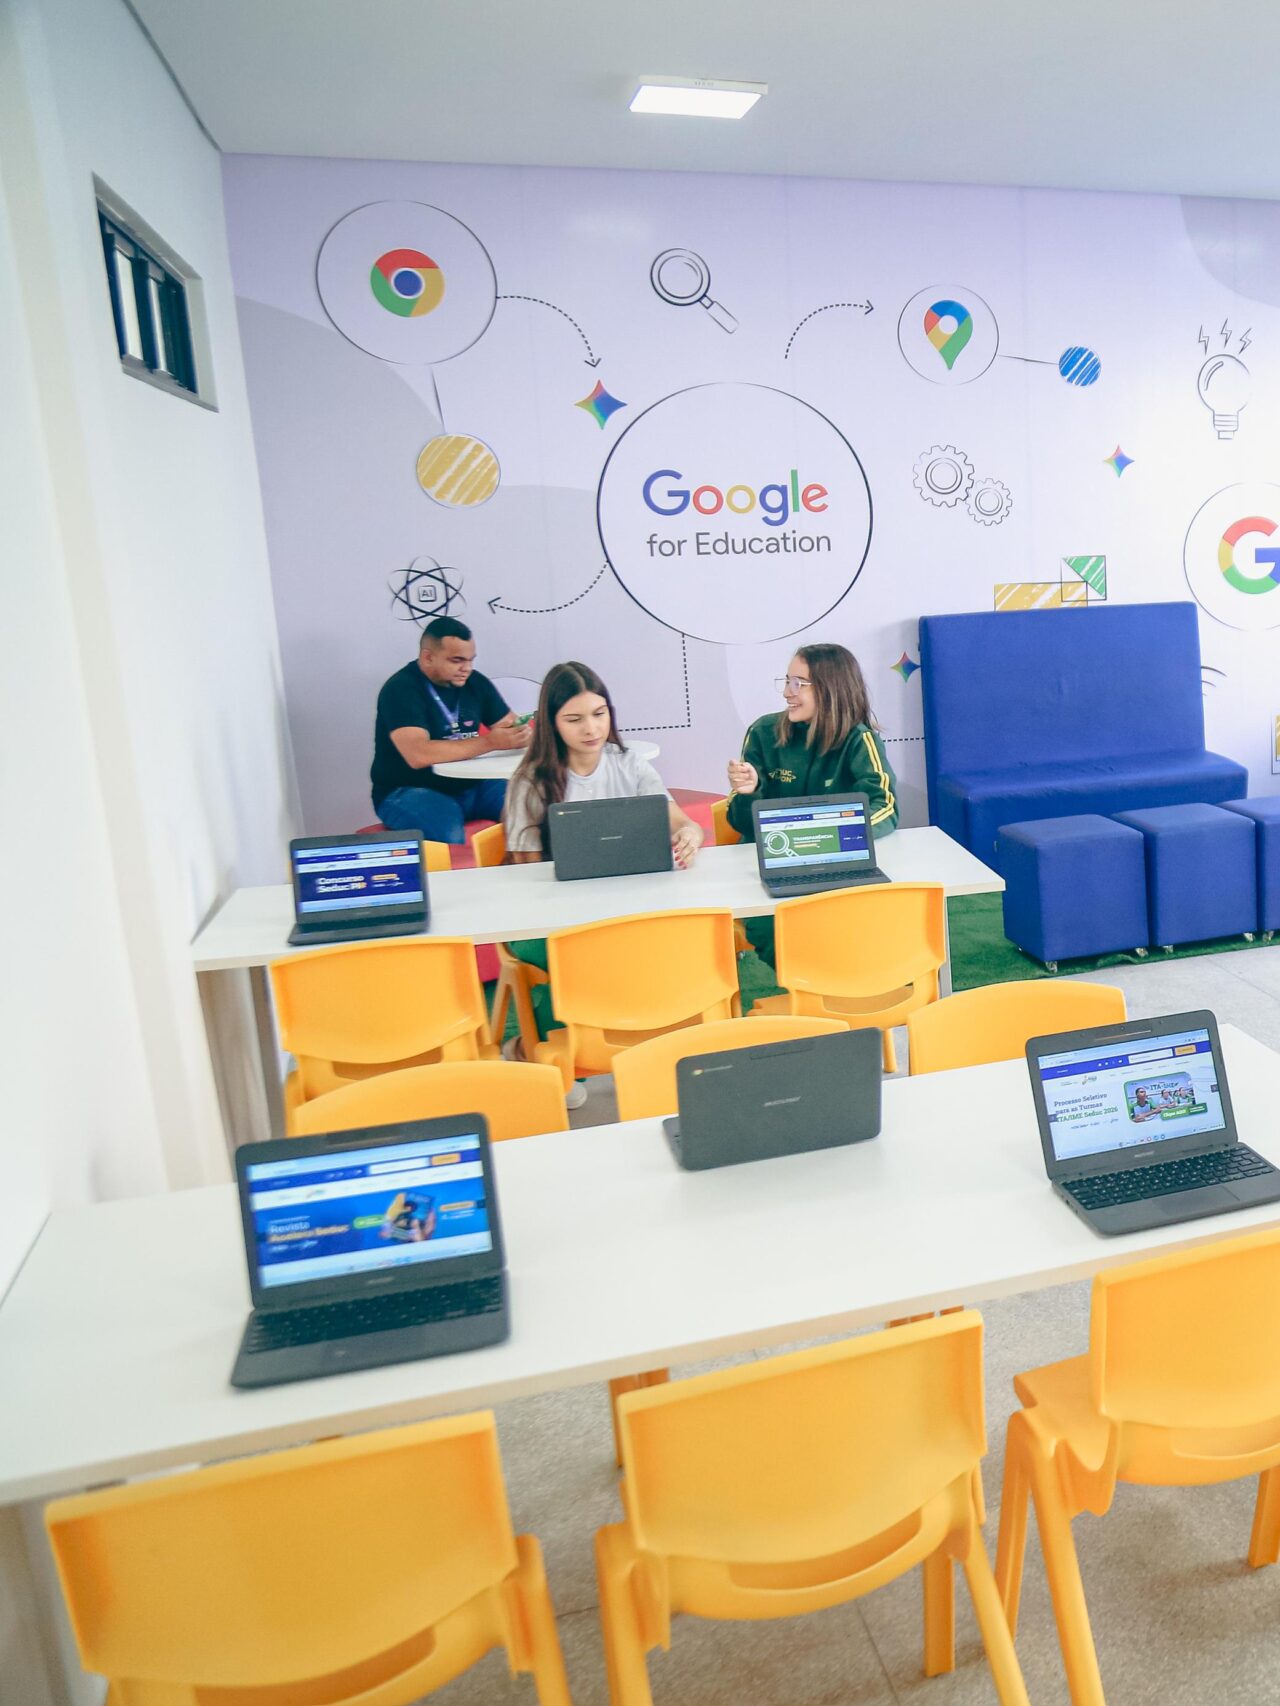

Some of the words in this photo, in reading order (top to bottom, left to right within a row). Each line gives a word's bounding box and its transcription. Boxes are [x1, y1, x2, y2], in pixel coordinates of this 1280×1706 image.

[643, 469, 829, 527] Google
[647, 533, 687, 557] for
[695, 530, 832, 556] Education
[422, 589, 433, 598] AI
[1054, 1098, 1082, 1108] Processo
[1083, 1093, 1107, 1102] Seletivo
[1080, 1102, 1103, 1111] Turmas
[1084, 1110, 1103, 1118] Seduc
[1104, 1106, 1118, 1115] 2026
